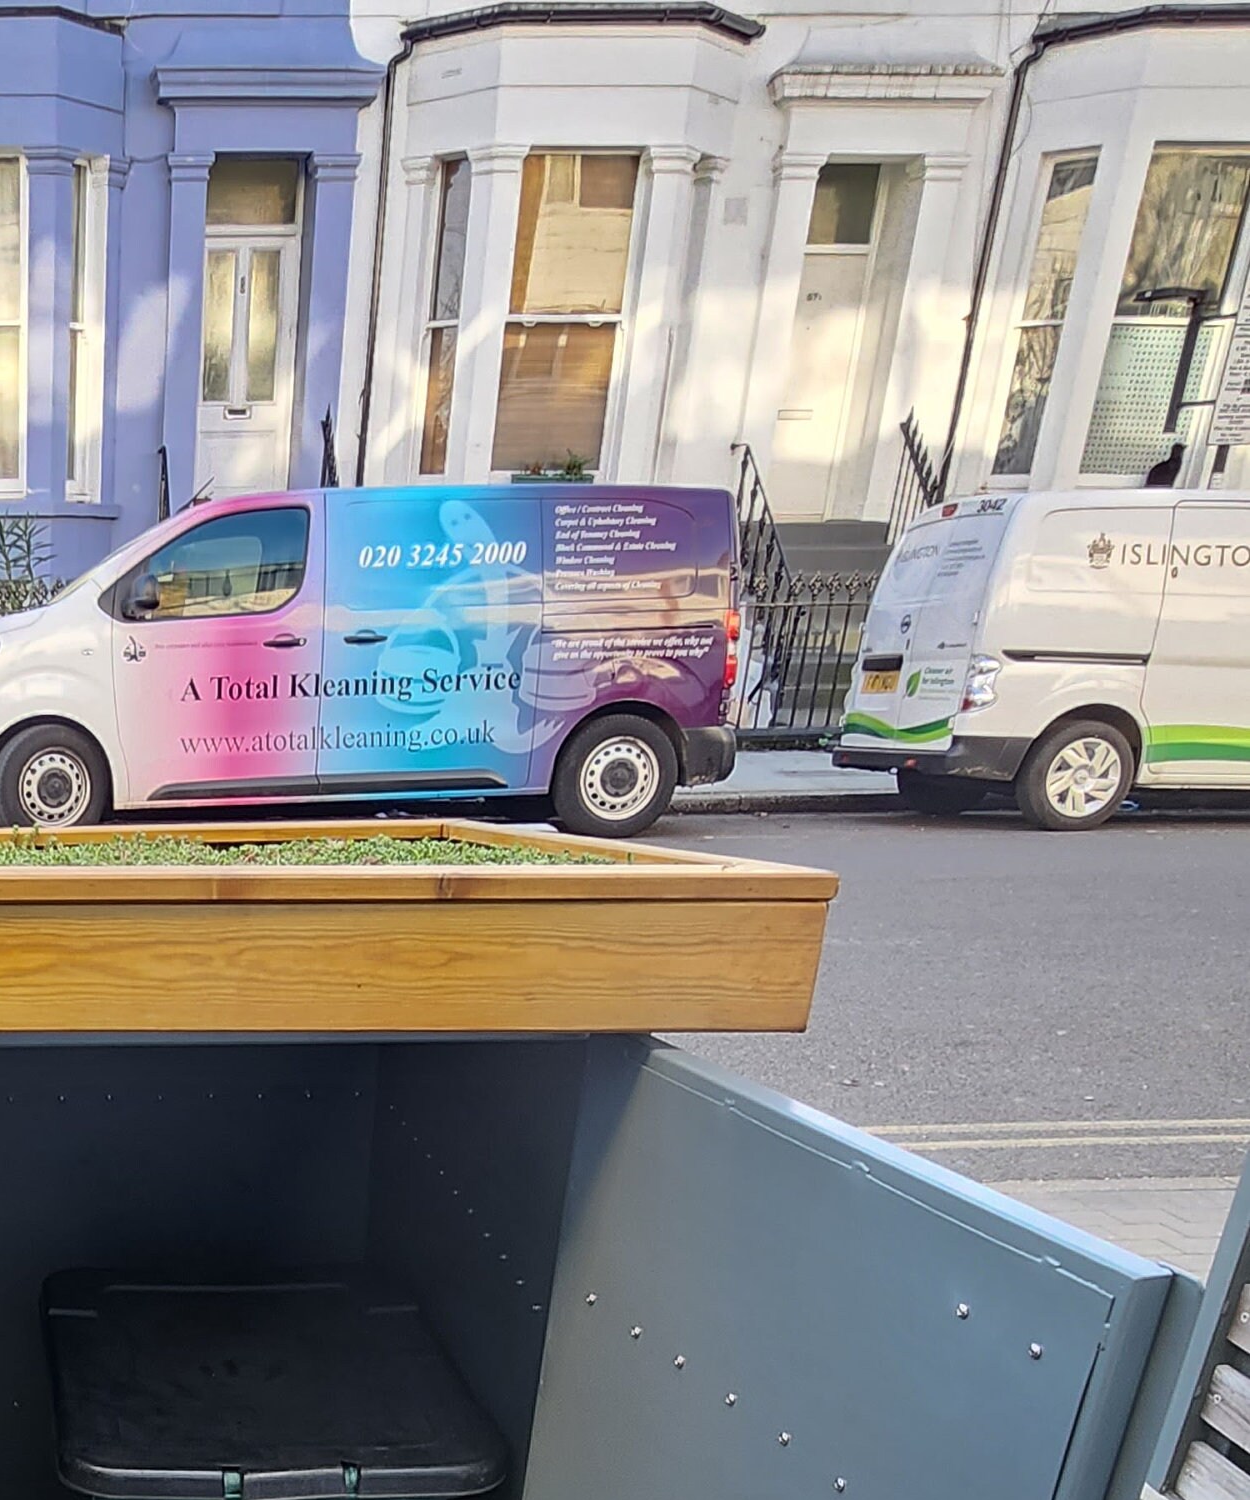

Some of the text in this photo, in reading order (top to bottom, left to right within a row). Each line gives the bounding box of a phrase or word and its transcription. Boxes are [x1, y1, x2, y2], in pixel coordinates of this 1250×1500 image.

[555, 505, 576, 515] Office
[613, 504, 644, 514] Cleaning
[976, 498, 1007, 513] 3042
[555, 518, 578, 528] Carpet
[626, 517, 657, 526] Cleaning
[555, 531, 570, 539] End
[609, 530, 640, 539] Cleaning
[645, 541, 676, 551] Cleaning
[359, 541, 527, 568] 020 3245 2000
[584, 556, 616, 565] Cleaning
[632, 580, 662, 590] Cleaning
[181, 667, 521, 702] A Total Kleaning Service
[180, 720, 496, 755] www.atotalkleaning.co.uk
